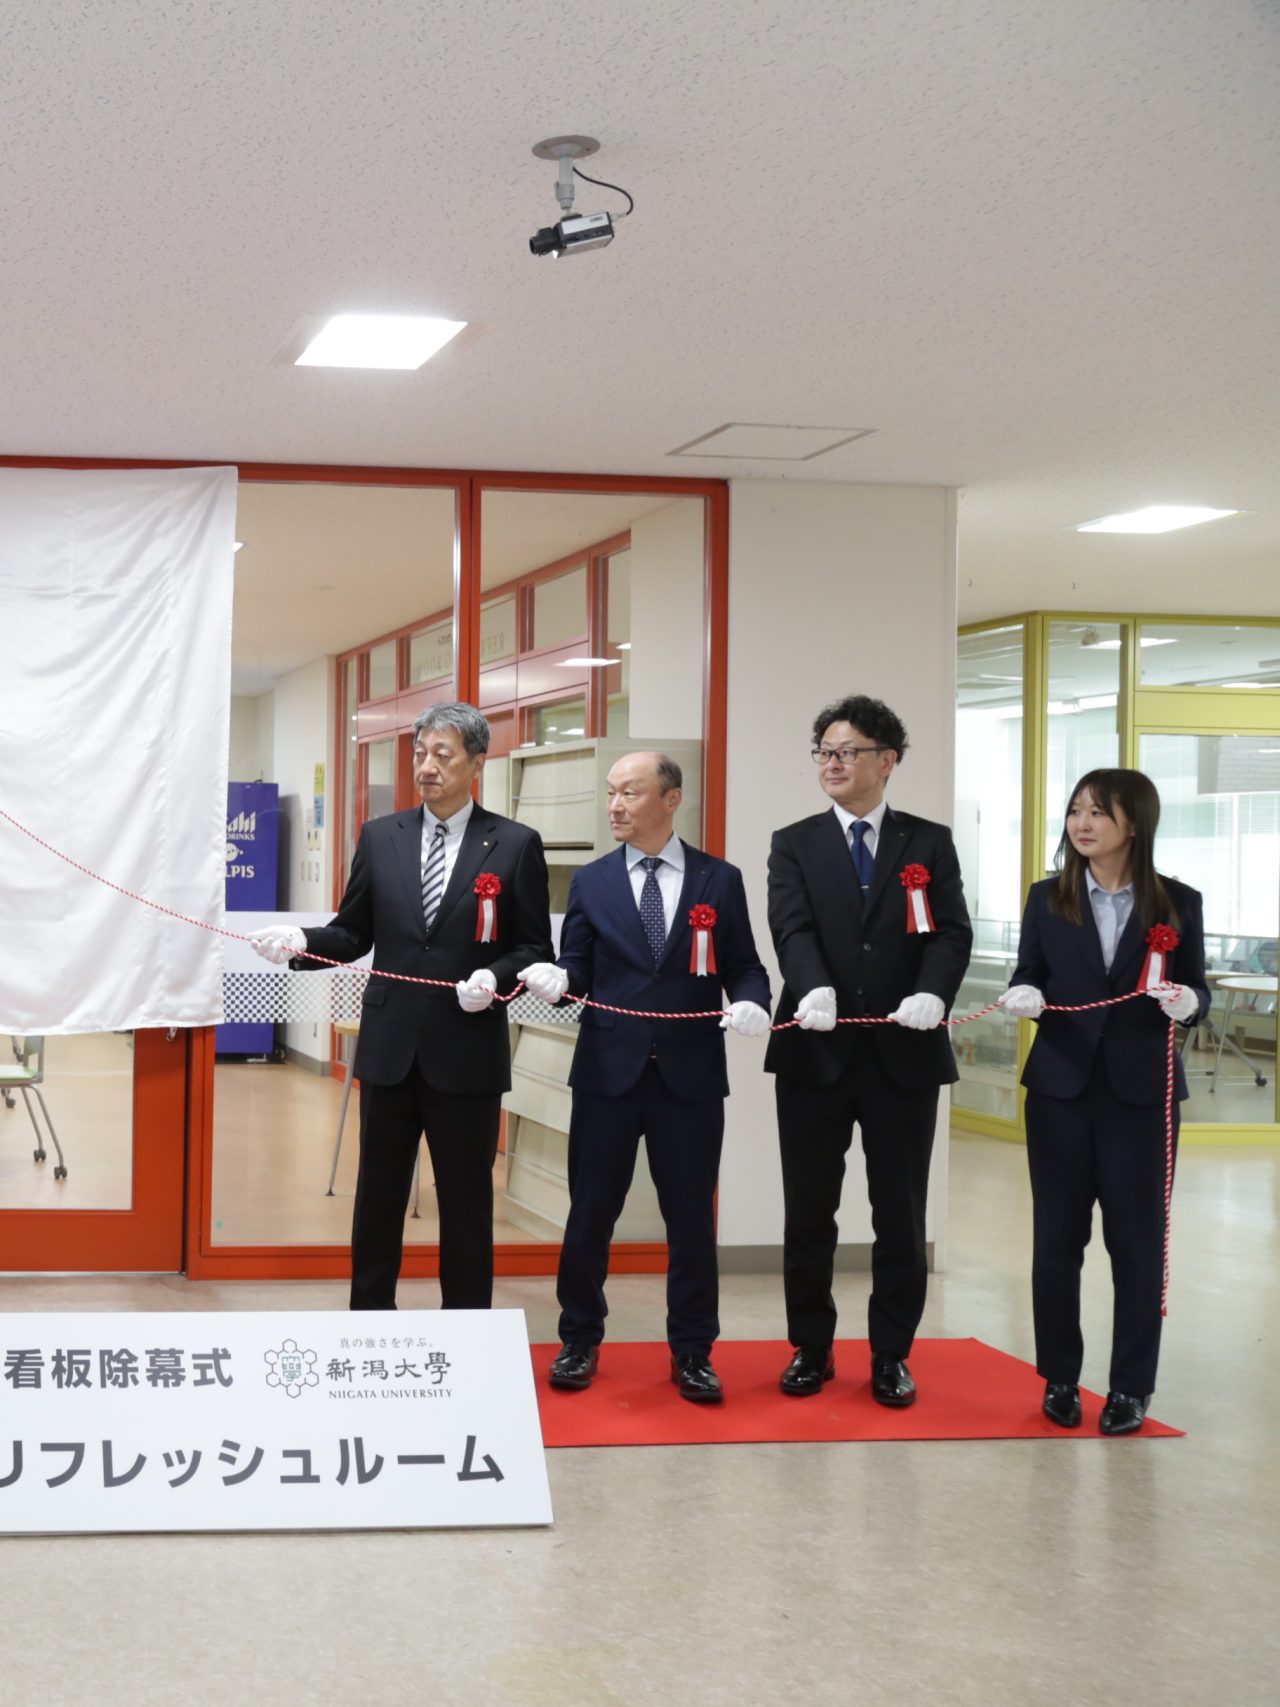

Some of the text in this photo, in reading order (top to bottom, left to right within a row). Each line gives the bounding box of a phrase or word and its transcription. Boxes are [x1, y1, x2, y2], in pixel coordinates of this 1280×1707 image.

[340, 1337, 434, 1349] 真の強さを学ぶ。
[325, 1352, 452, 1385] 新潟大學
[329, 1388, 453, 1400] NIIGATA UNIVERSITY
